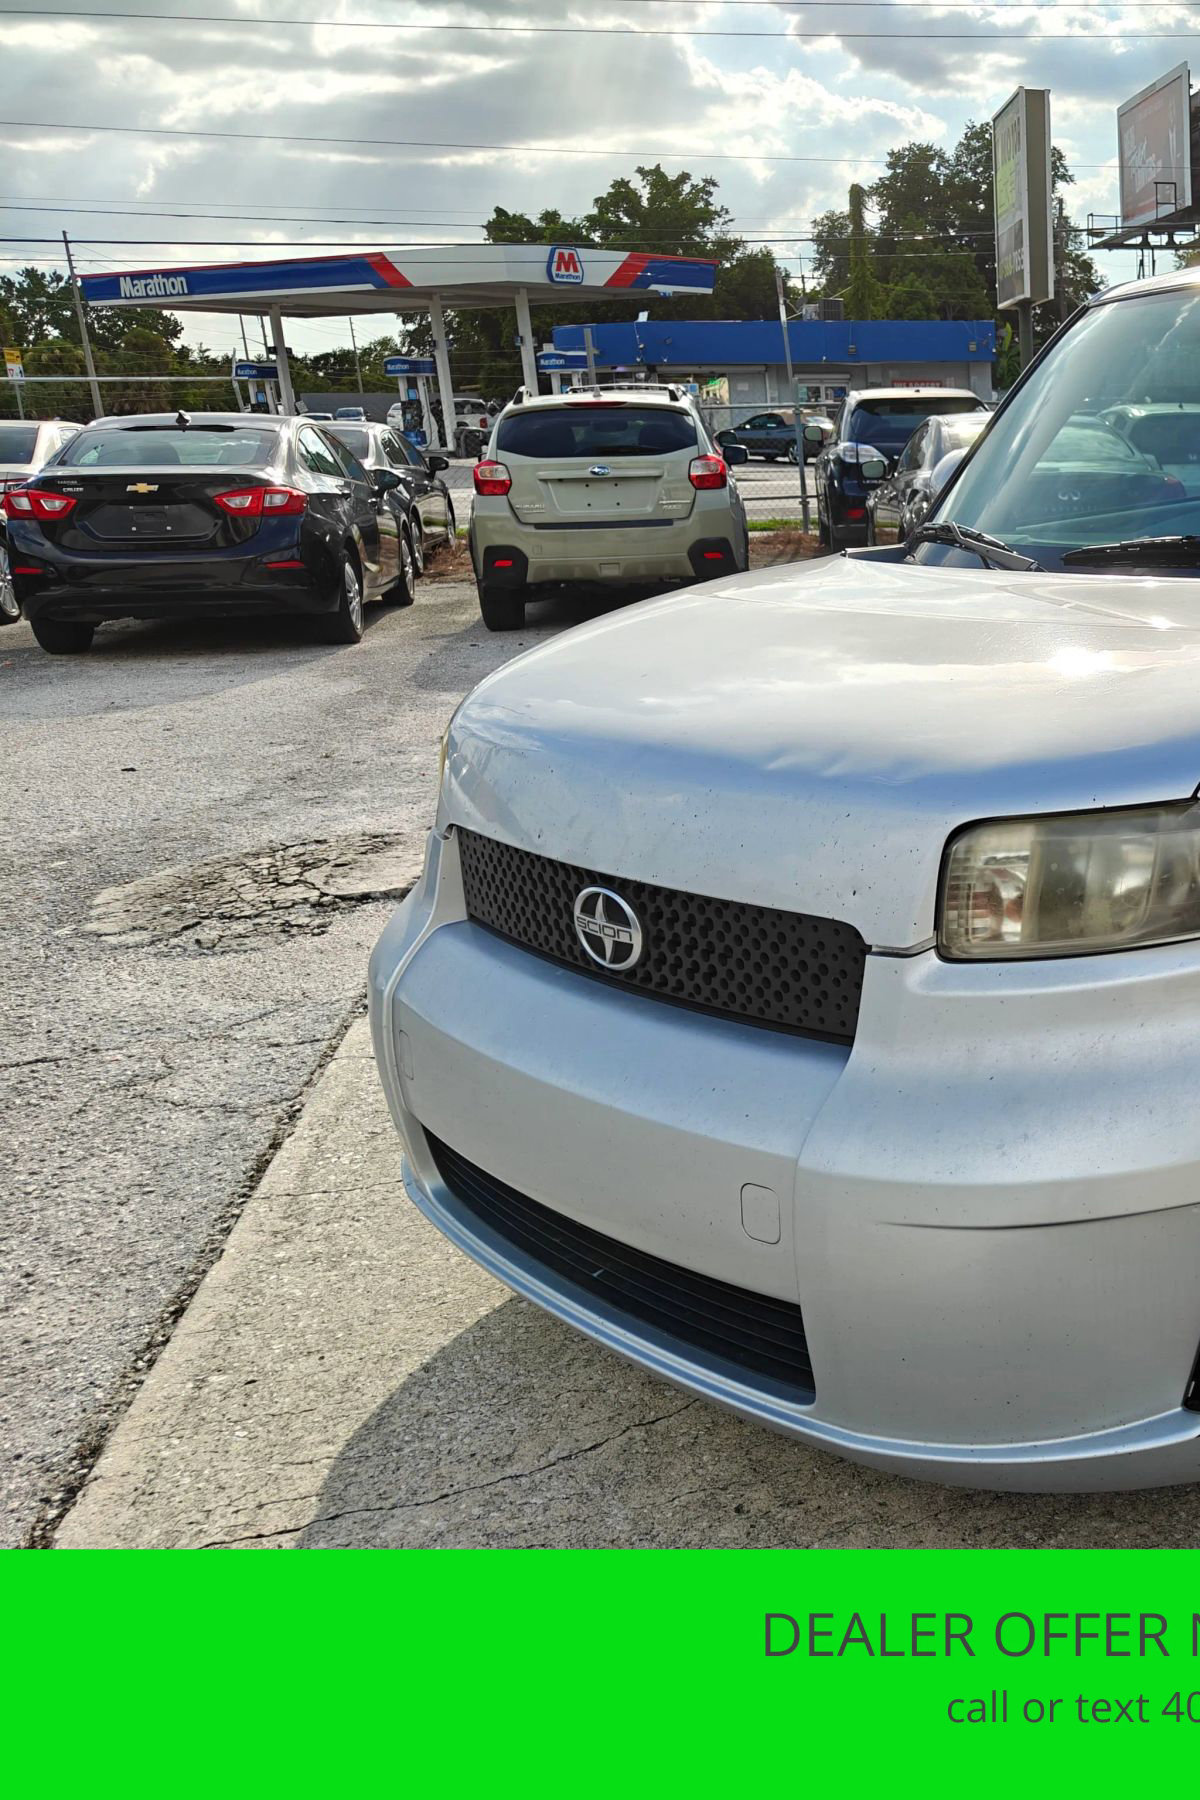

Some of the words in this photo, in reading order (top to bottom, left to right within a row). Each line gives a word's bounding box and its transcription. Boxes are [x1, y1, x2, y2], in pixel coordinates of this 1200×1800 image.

[556, 251, 579, 273] M
[119, 274, 188, 297] Marathon
[576, 915, 632, 942] SCION
